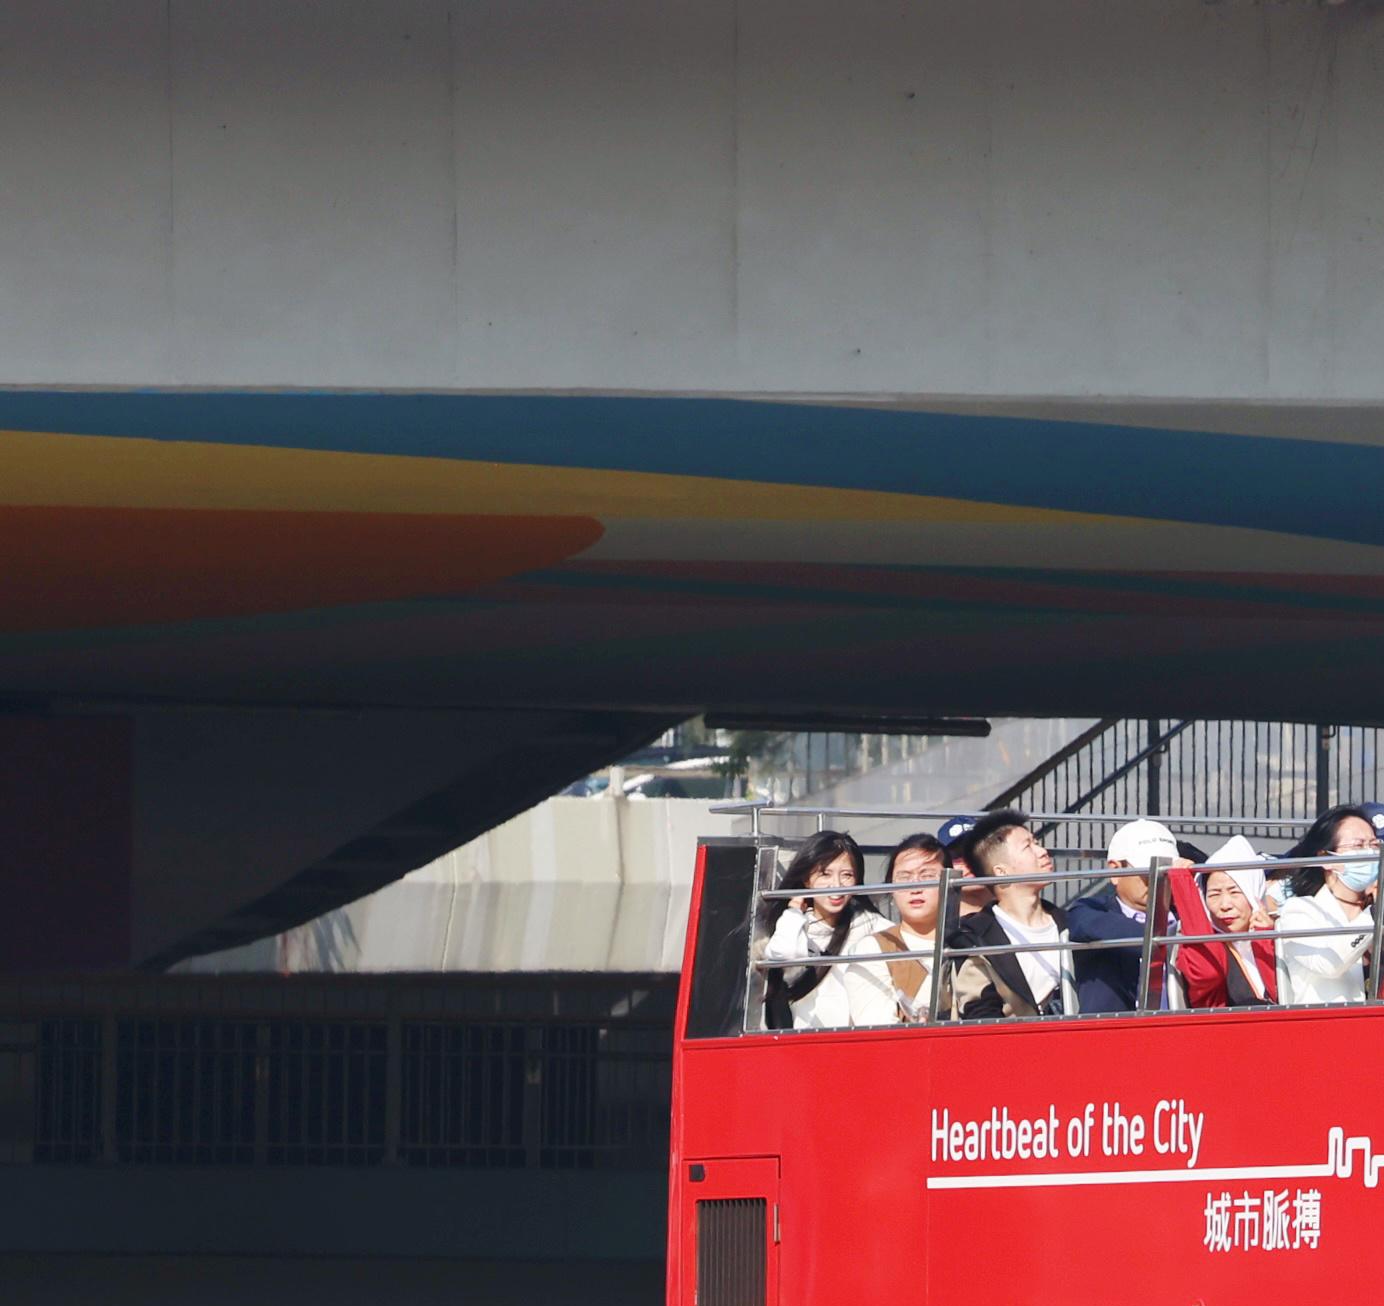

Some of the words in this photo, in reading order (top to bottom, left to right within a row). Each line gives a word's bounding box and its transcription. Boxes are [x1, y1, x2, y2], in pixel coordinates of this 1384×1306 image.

[931, 1104, 1060, 1162] Heartbeat
[1067, 1102, 1095, 1158] of
[1102, 1101, 1146, 1157] the
[1153, 1099, 1204, 1168] City
[1203, 1188, 1322, 1253] 城市脈搏
